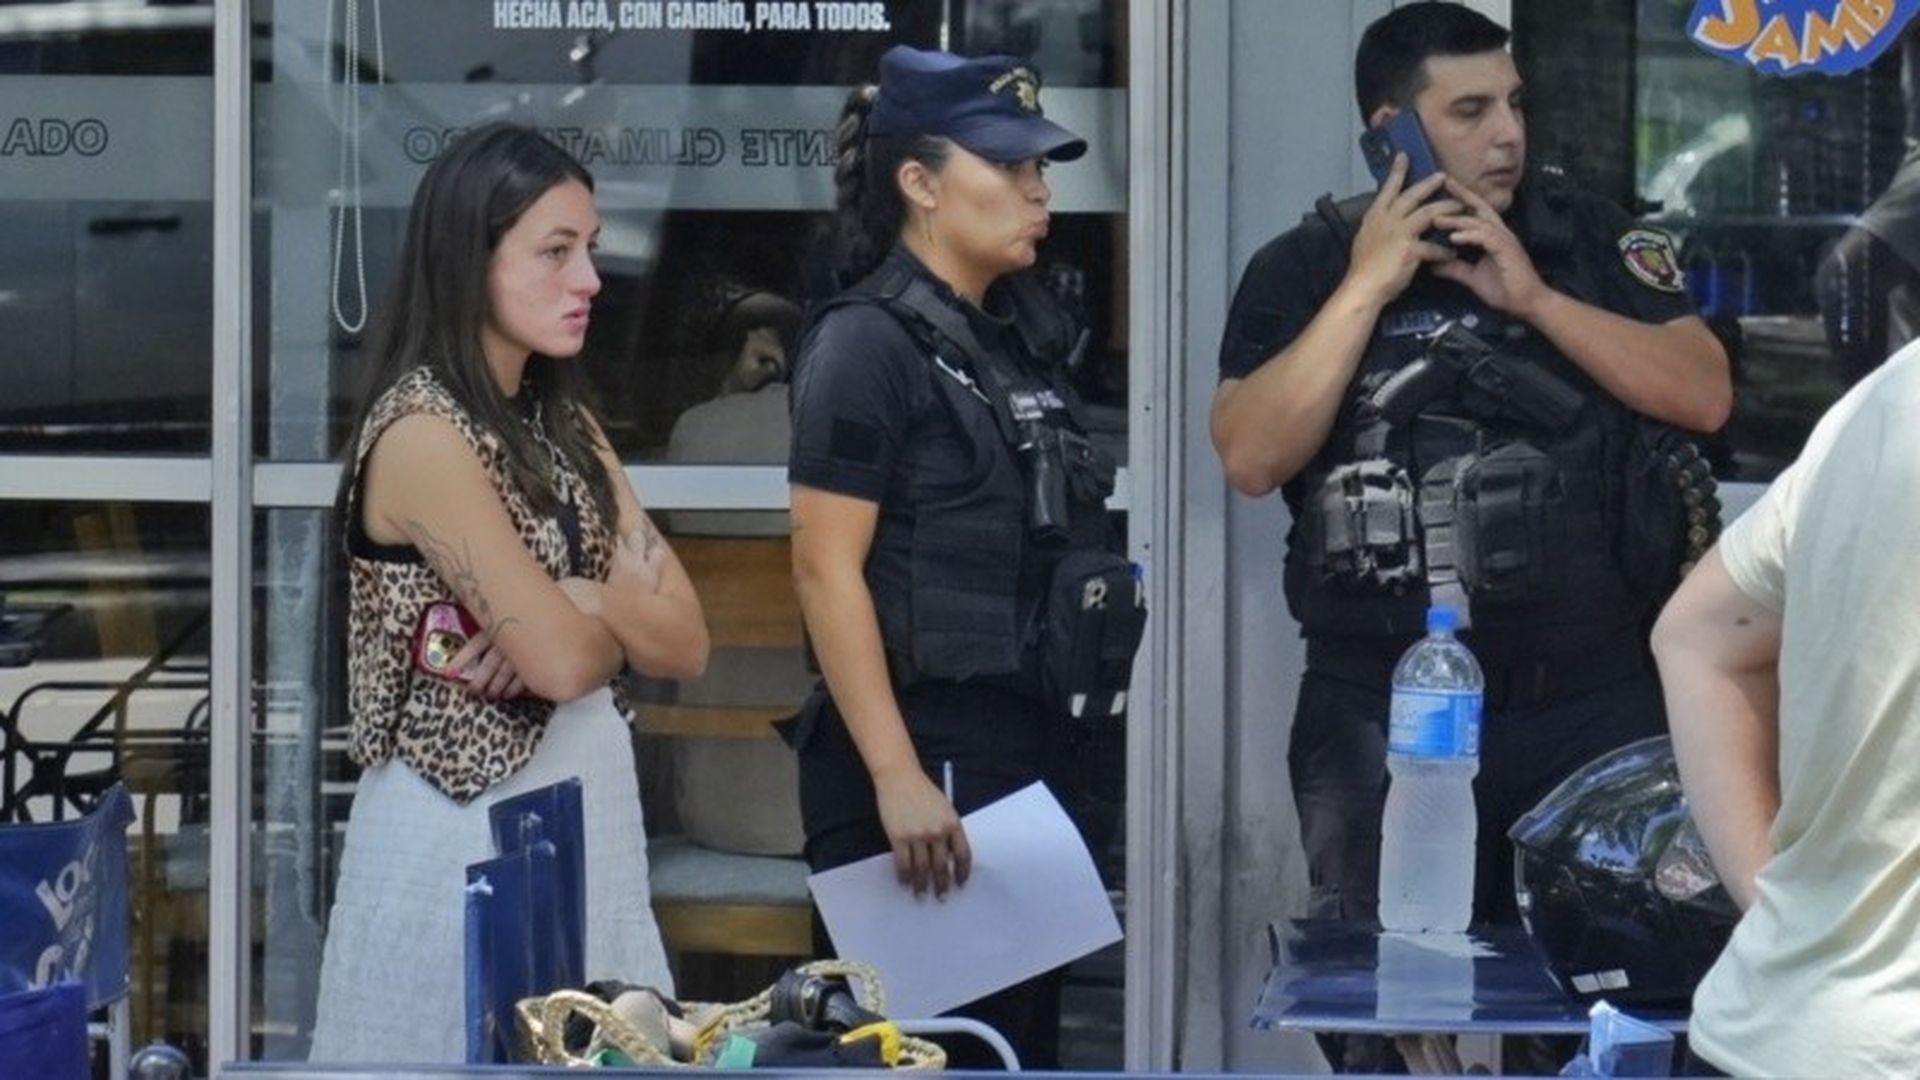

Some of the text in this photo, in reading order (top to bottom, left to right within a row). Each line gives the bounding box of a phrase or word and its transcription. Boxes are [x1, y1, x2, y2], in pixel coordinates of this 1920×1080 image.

[493, 1, 561, 28] HECHA
[619, 1, 662, 28] CON
[666, 0, 751, 34] CARIÑO,
[756, 2, 811, 30] PARA
[815, 2, 891, 31] TODOS.
[0, 117, 109, 157] ADO
